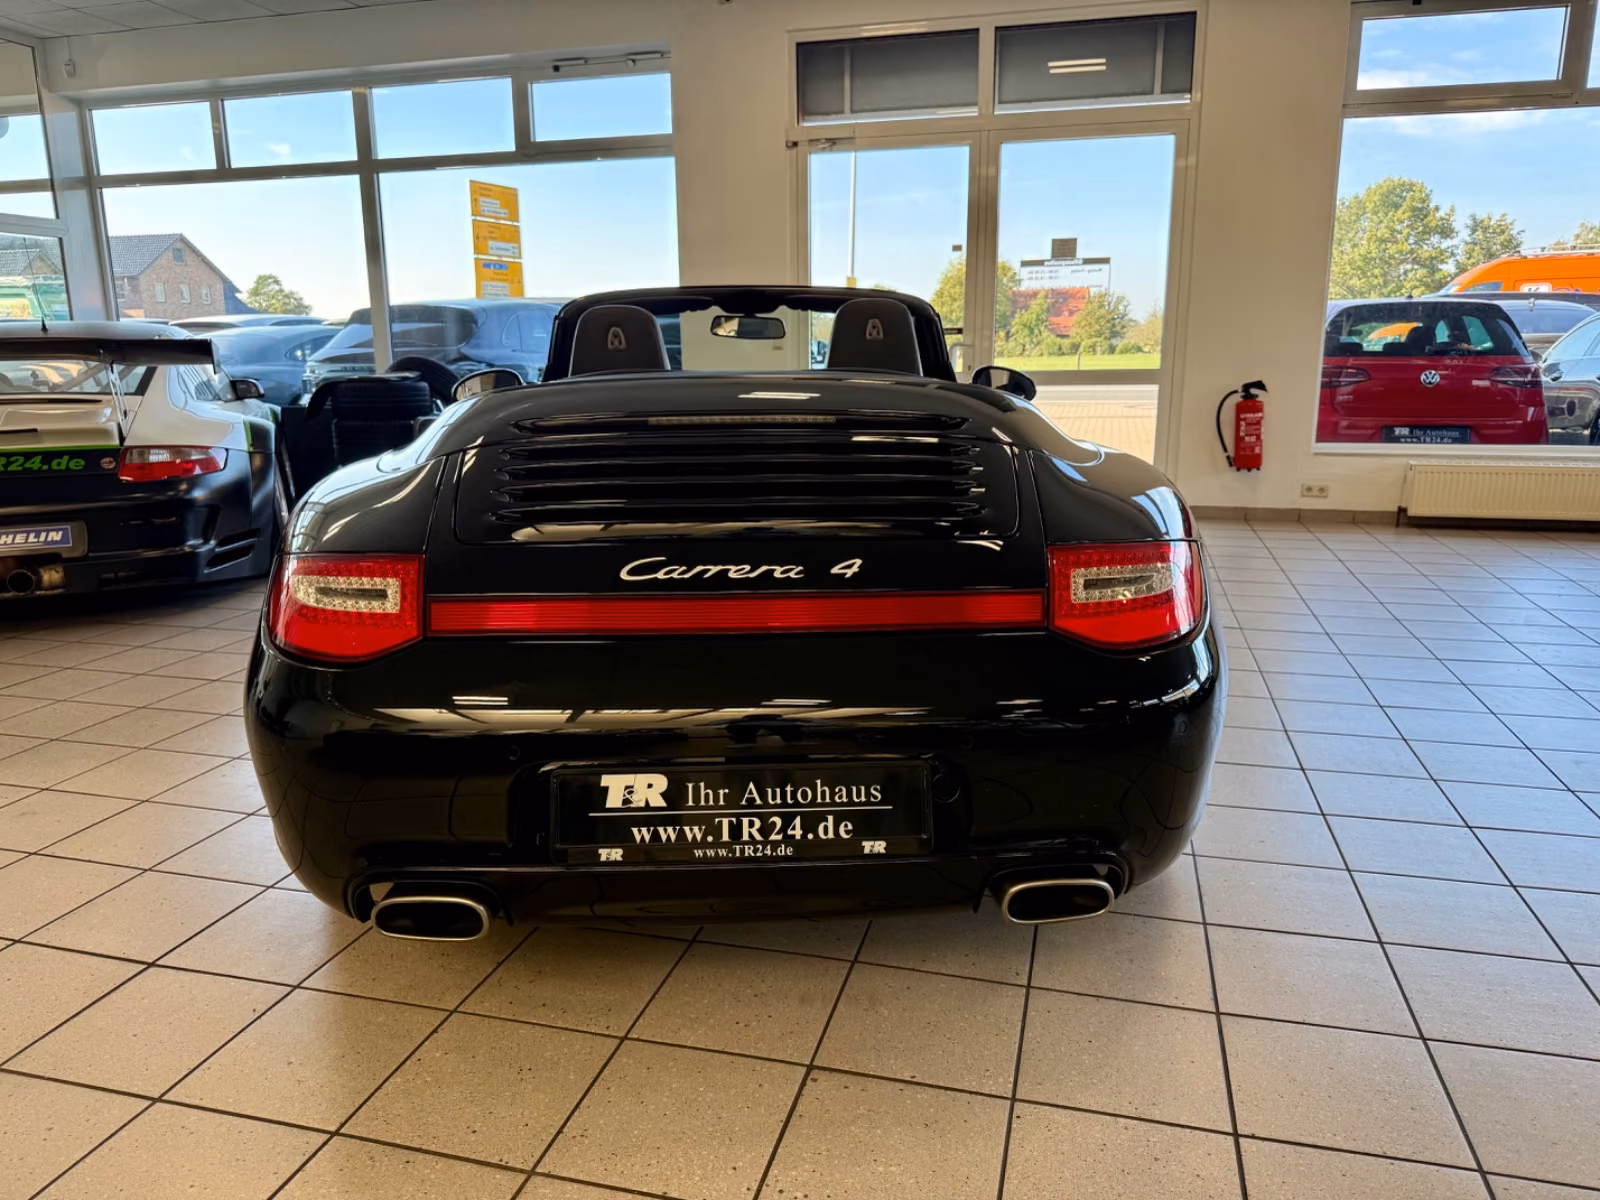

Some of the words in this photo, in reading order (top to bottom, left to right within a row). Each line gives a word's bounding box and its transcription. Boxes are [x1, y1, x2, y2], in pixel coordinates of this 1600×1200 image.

[1426, 429, 1460, 437] Autohaus
[620, 557, 804, 581] Carrera
[830, 558, 862, 578] 4
[685, 781, 729, 806] Ihr
[740, 779, 882, 805] Autohaus
[630, 815, 853, 844] www.TR24.de
[693, 844, 794, 858] www.TR24.de
